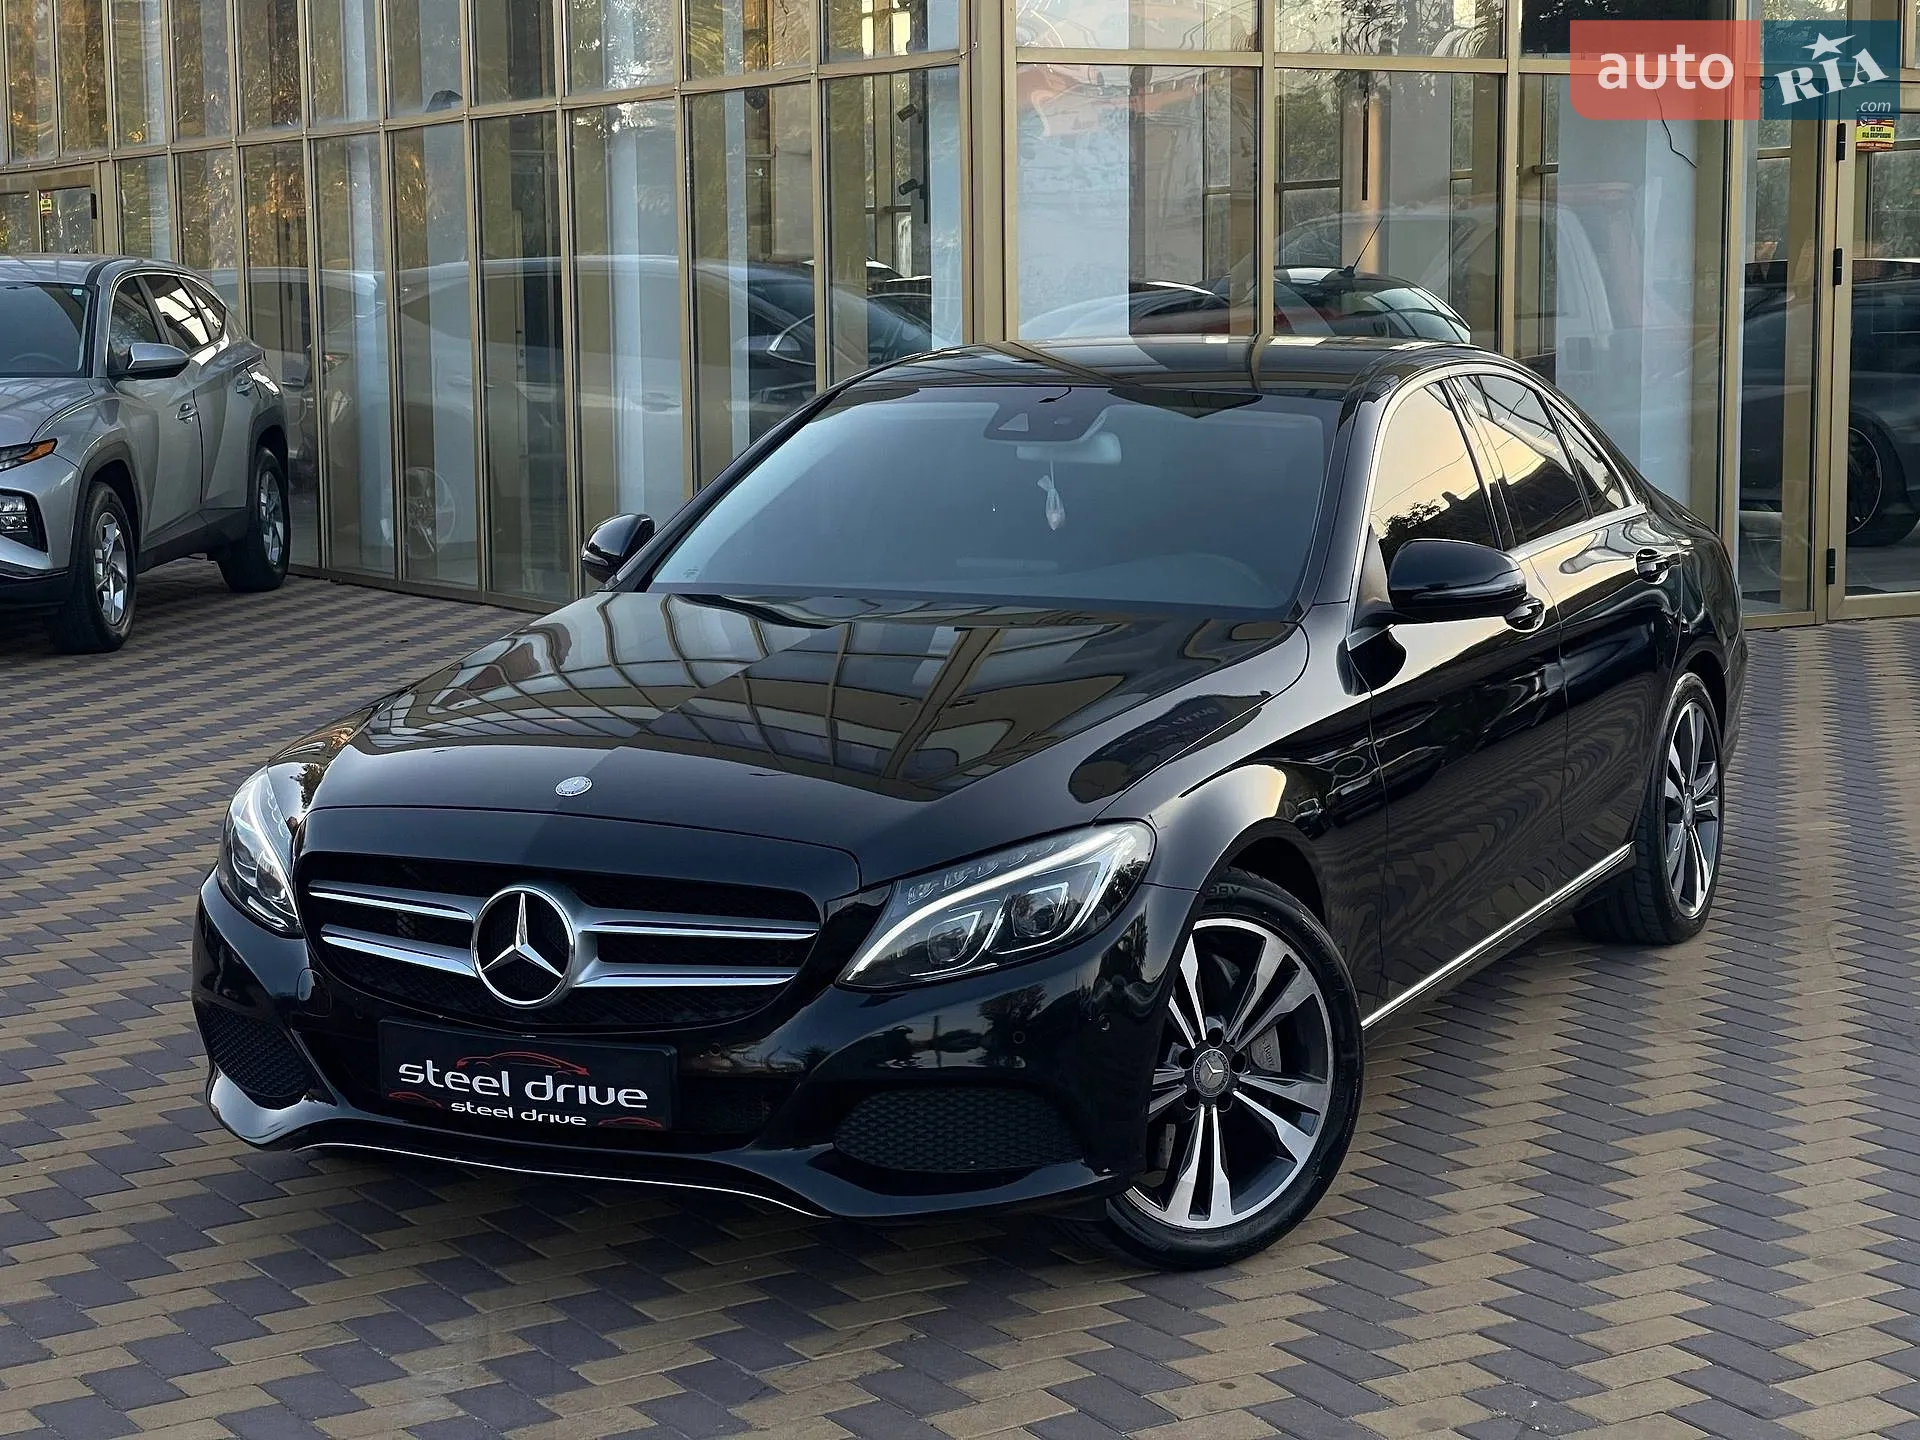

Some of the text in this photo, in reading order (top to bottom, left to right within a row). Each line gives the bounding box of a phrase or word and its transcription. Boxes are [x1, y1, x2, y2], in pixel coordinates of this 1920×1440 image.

[398, 1059, 649, 1109] steel drive
[450, 1101, 587, 1126] steel drive
